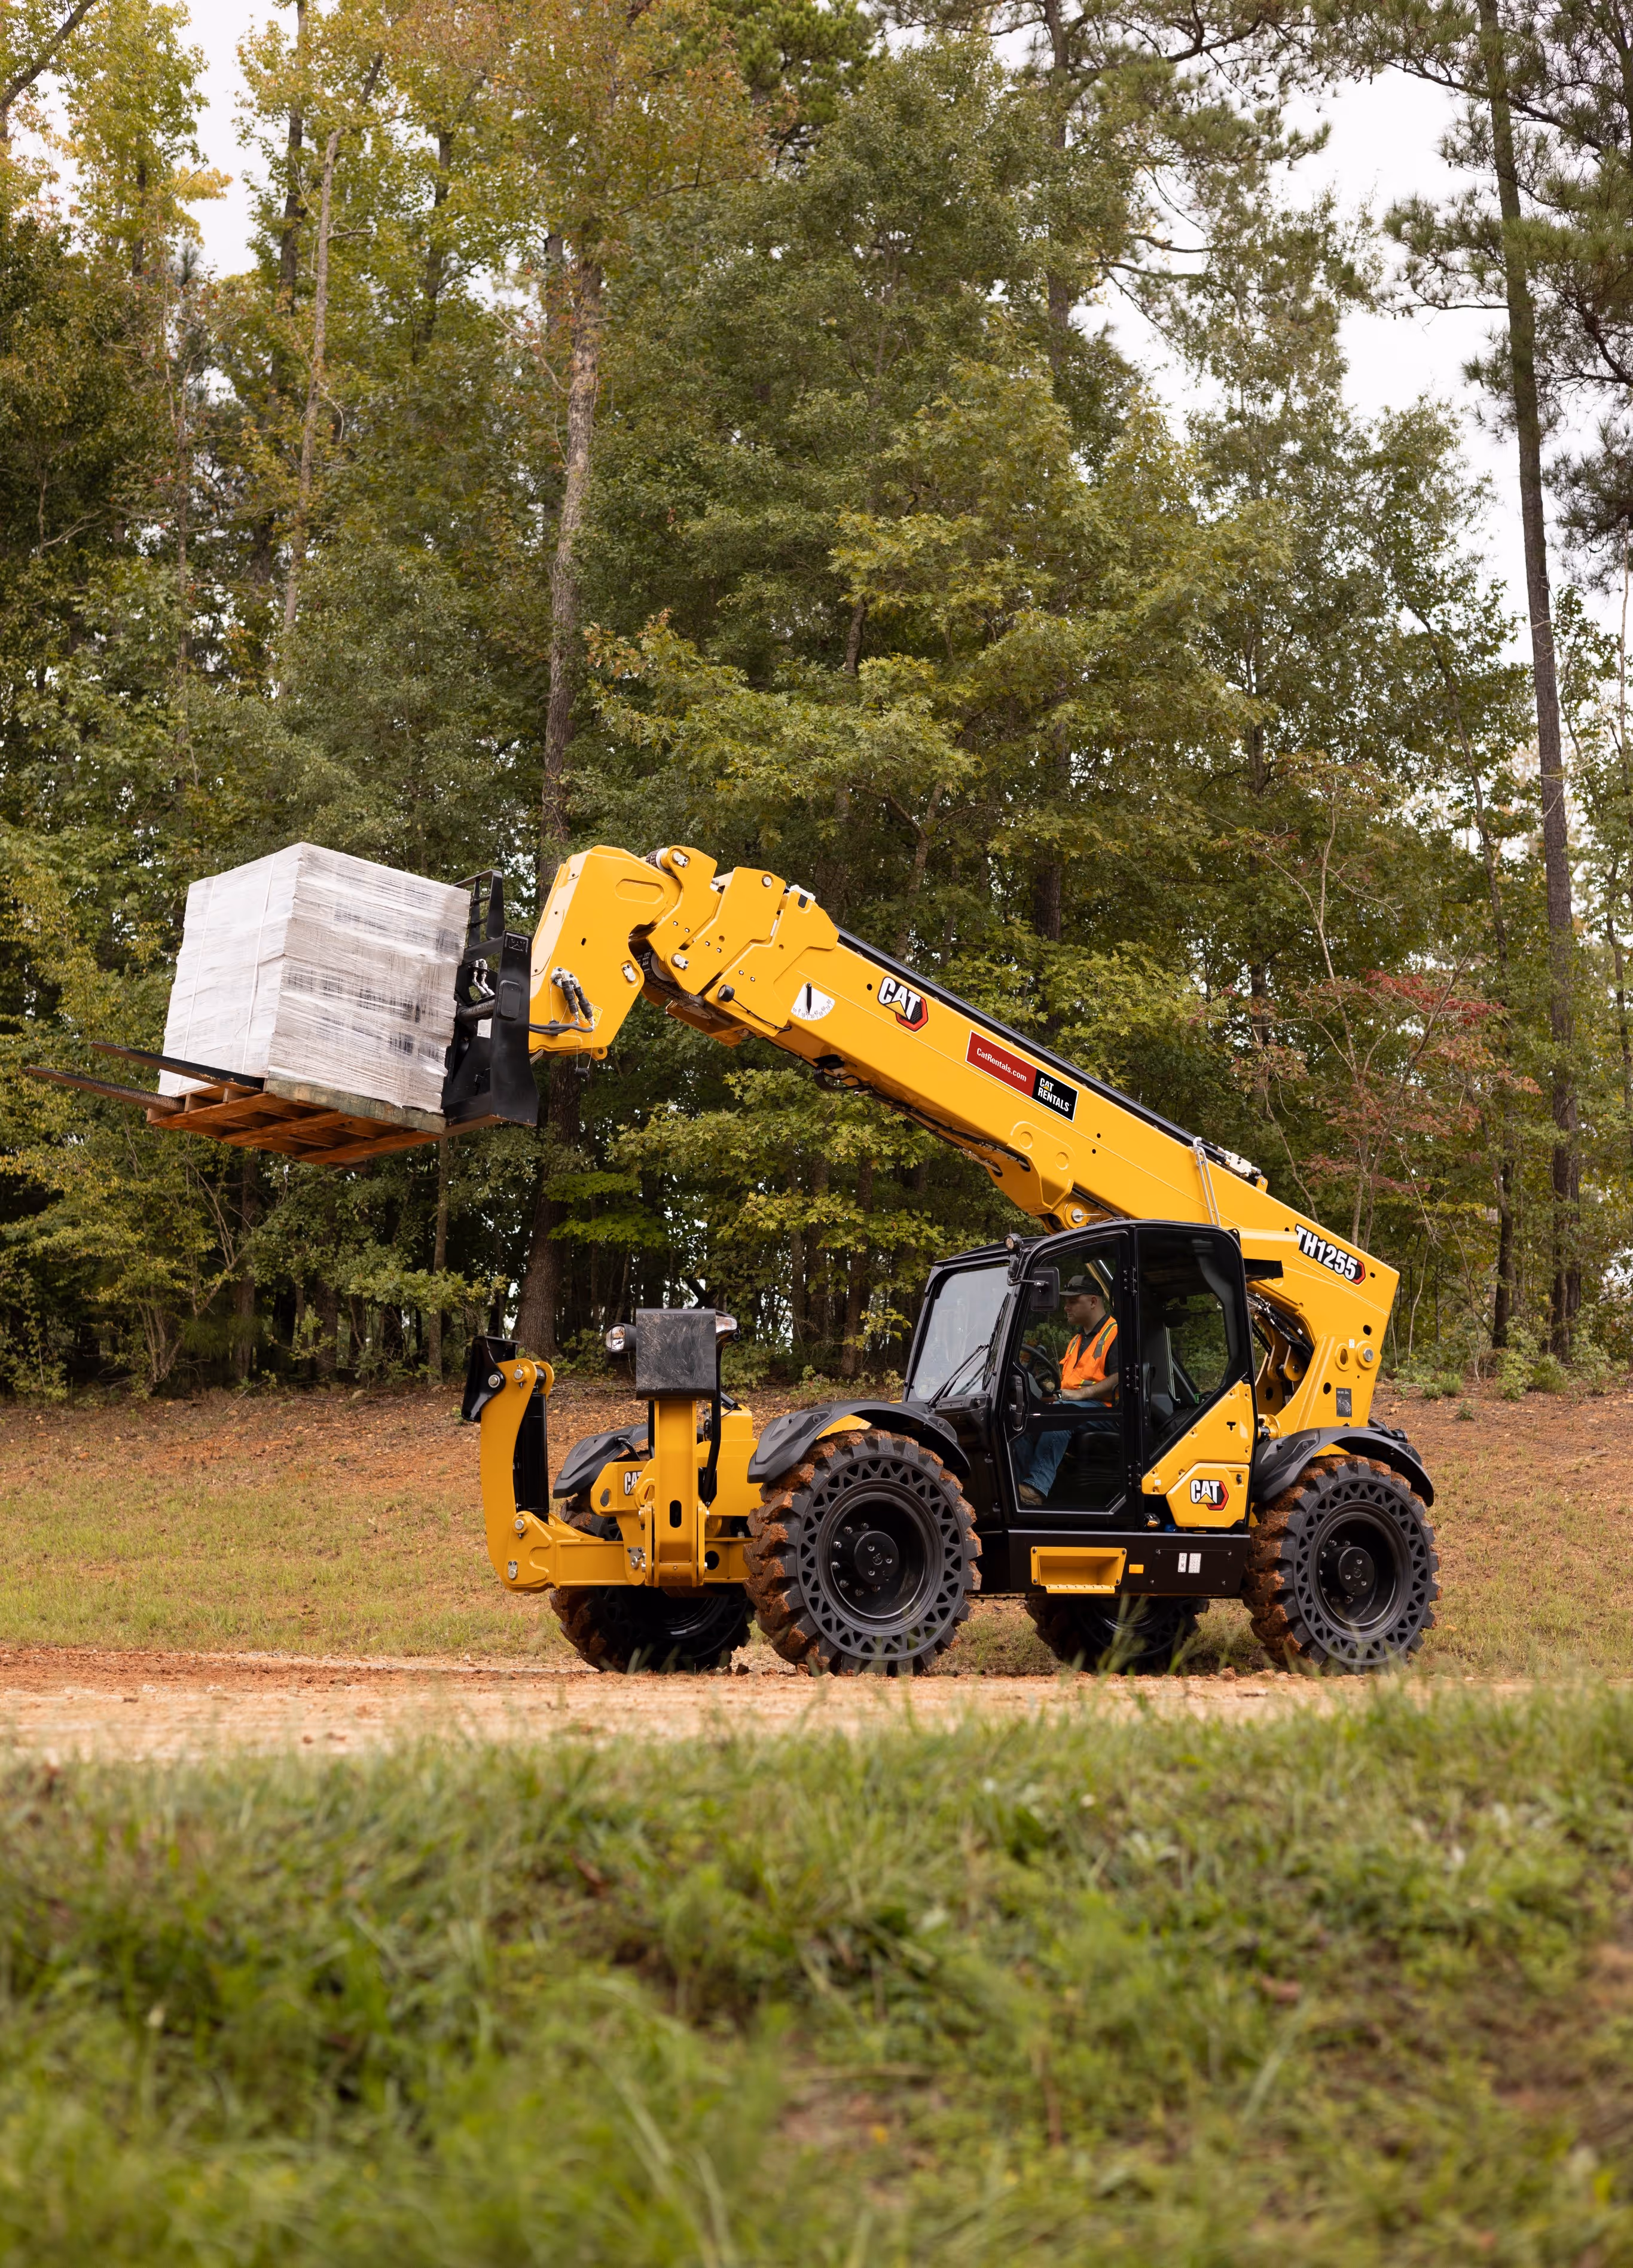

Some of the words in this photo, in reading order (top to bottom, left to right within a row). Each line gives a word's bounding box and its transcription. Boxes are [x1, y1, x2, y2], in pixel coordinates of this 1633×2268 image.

[878, 976, 921, 1020] CAT
[976, 1047, 1027, 1082] CatRentals.com
[1037, 1086, 1070, 1112] RENTALS
[1039, 1077, 1054, 1093] CAT
[1296, 1224, 1358, 1280] TH1255
[1191, 1480, 1220, 1504] CAT
